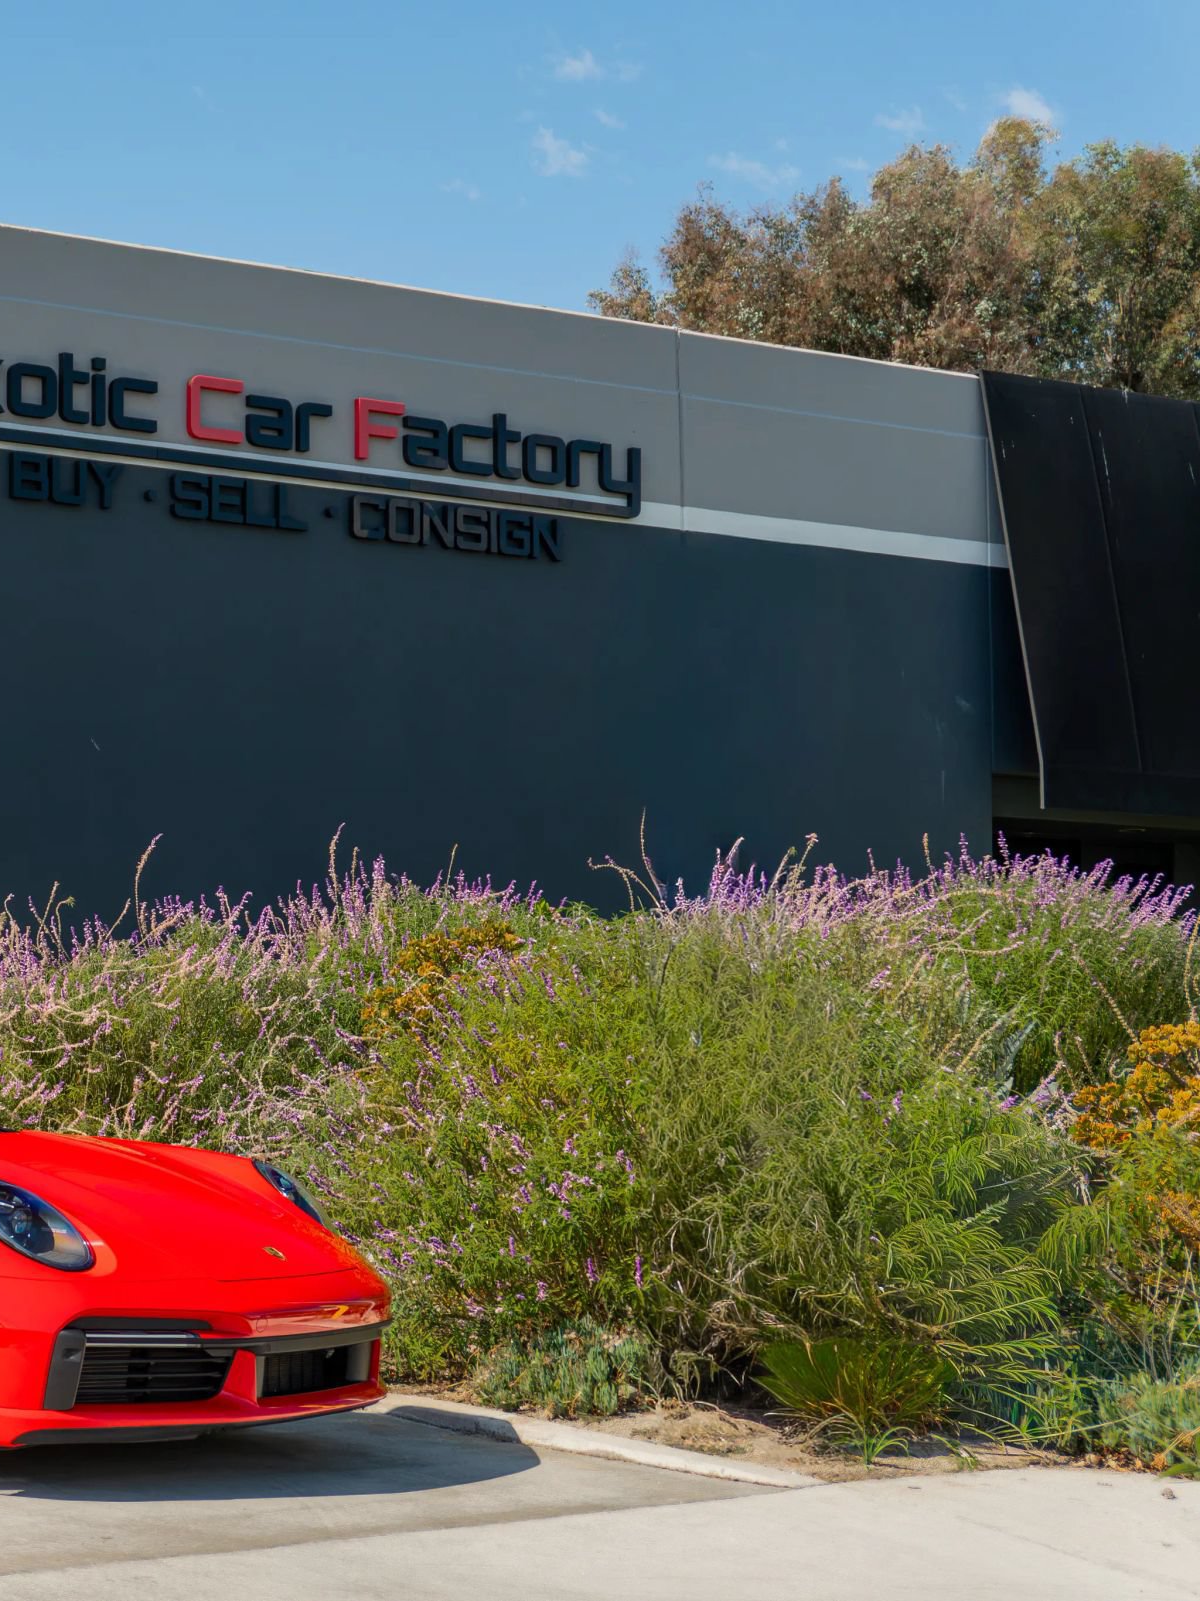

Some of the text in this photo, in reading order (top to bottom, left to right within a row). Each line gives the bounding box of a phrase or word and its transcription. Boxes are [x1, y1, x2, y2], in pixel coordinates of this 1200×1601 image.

[9, 451, 562, 562] BUY SELL CONSIGN
[187, 375, 333, 453] Car
[354, 397, 641, 518] Factory
